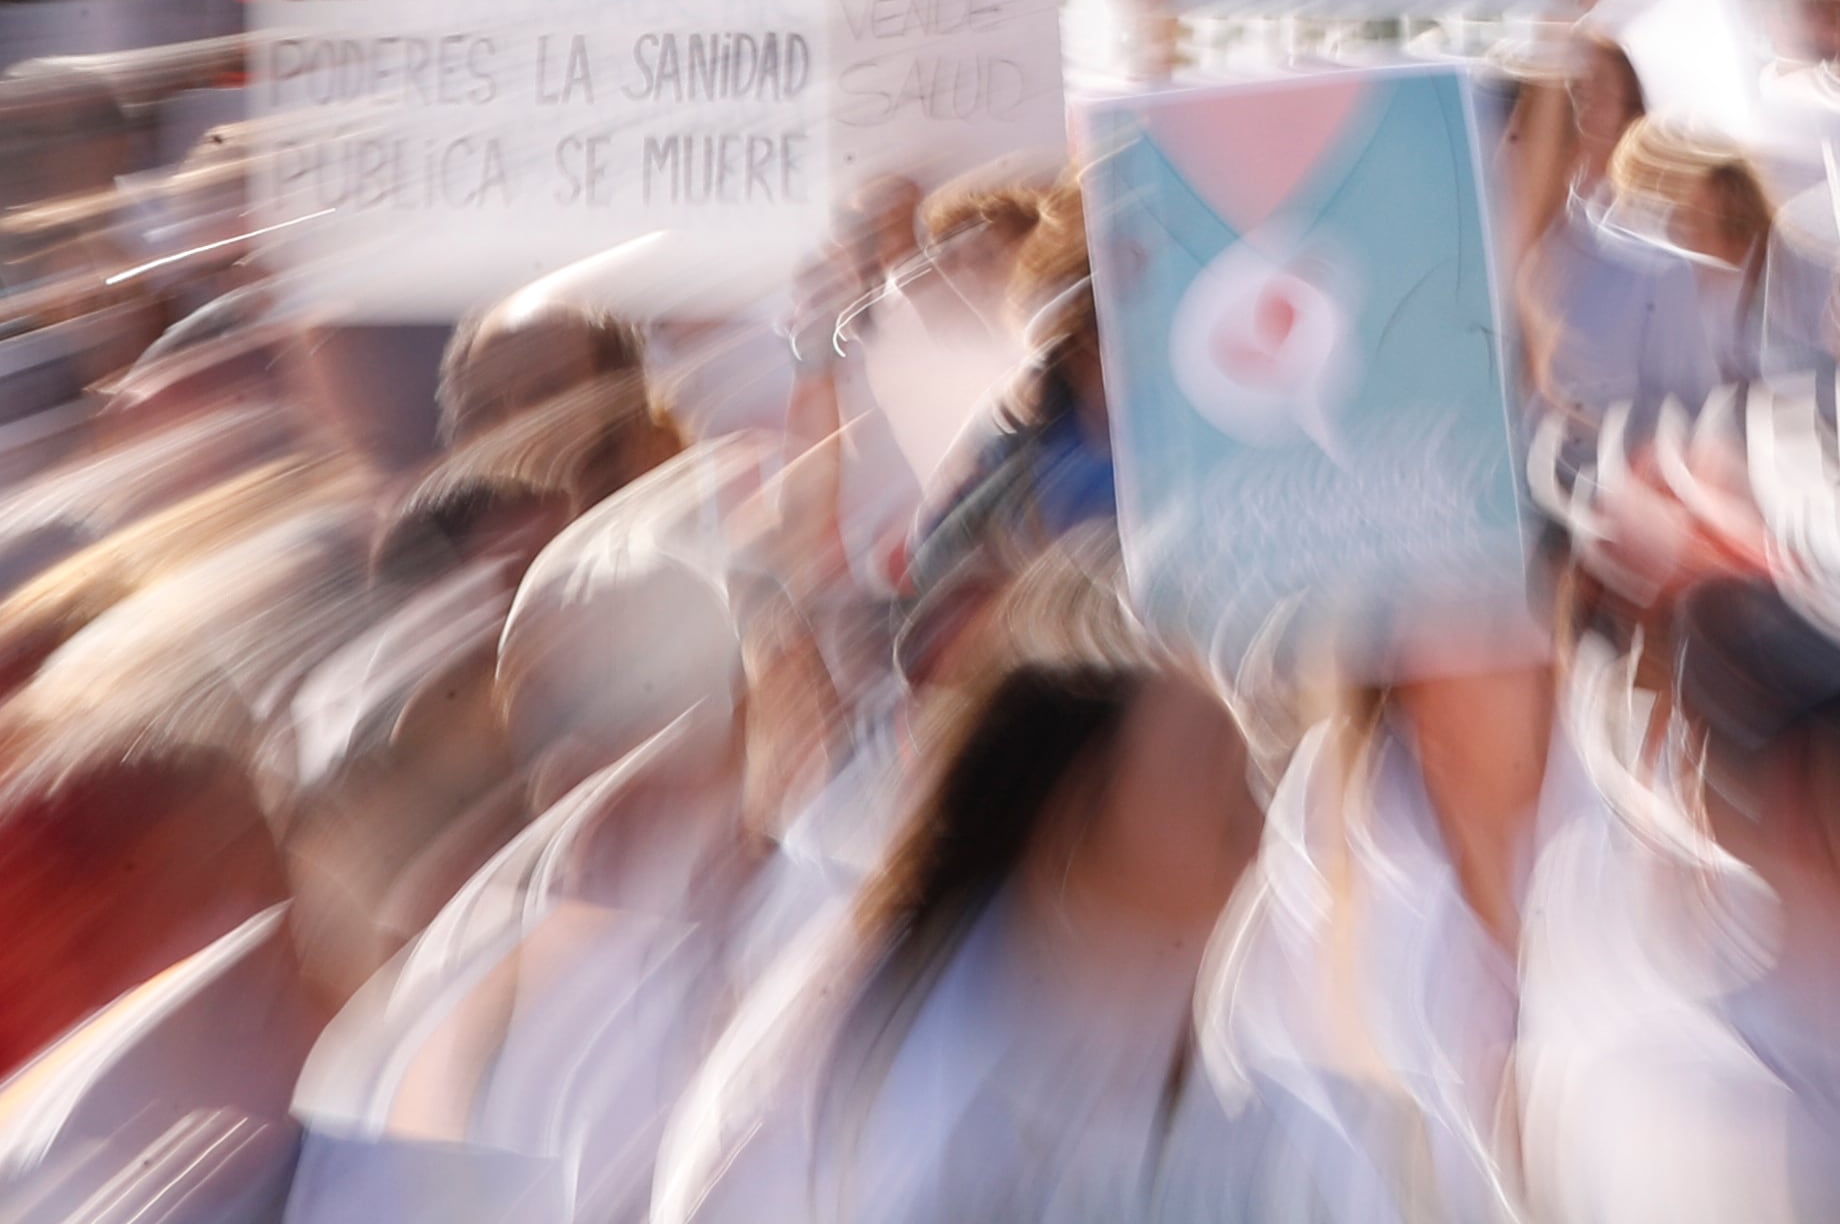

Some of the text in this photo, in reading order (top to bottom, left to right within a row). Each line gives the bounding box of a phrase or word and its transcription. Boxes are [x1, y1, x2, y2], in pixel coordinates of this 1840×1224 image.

[270, 32, 497, 106] PODERES
[534, 32, 596, 105] LA
[833, 54, 1025, 126] SALUD
[553, 134, 611, 207] SE
[642, 133, 810, 207] MUERE
